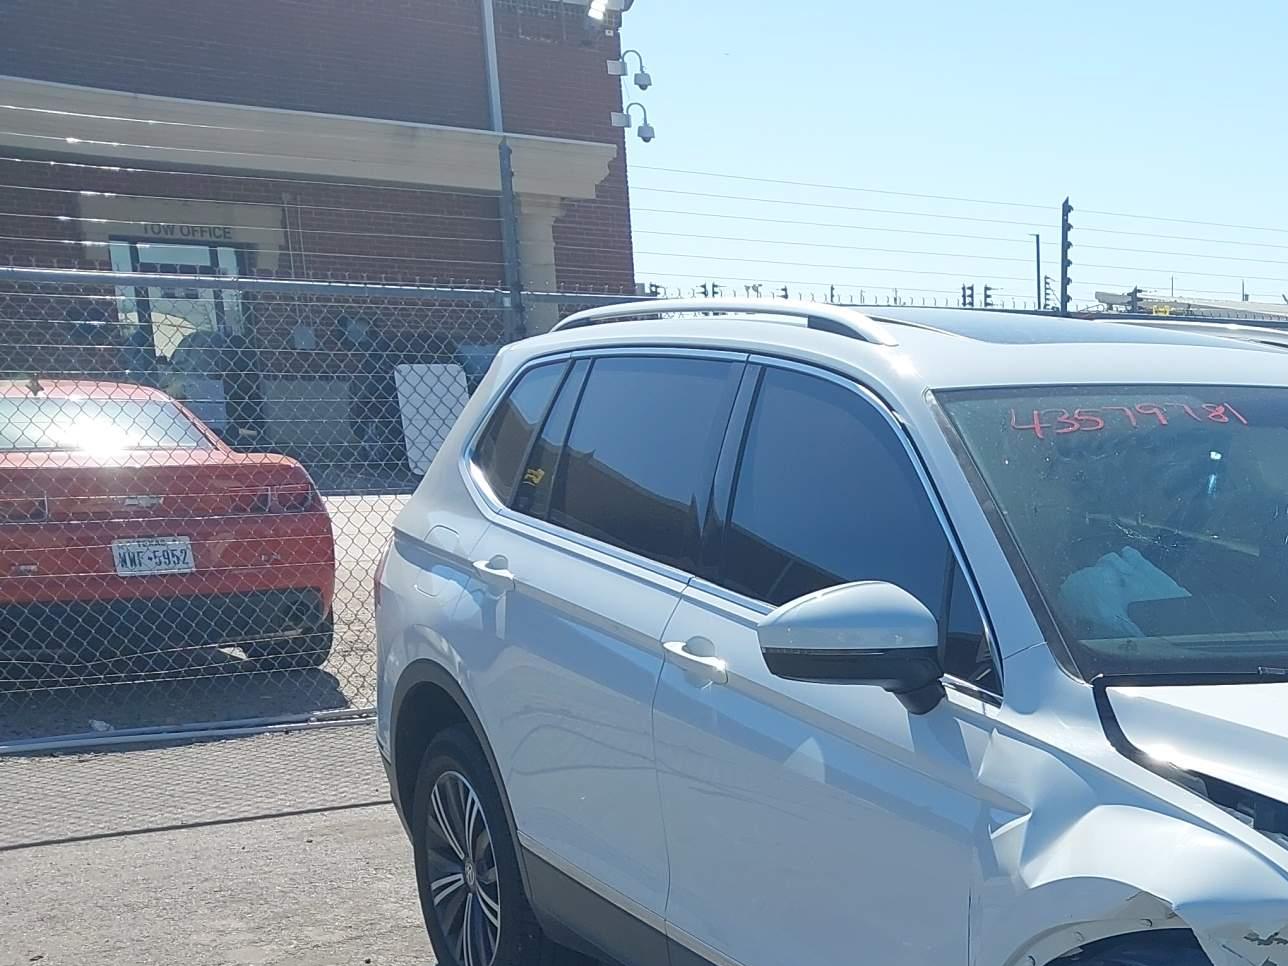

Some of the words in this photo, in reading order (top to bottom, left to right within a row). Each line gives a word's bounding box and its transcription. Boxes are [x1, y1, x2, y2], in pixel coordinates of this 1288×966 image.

[143, 223, 176, 236] TOW
[180, 225, 233, 240] OFFICE
[1010, 402, 1248, 439] 43579781
